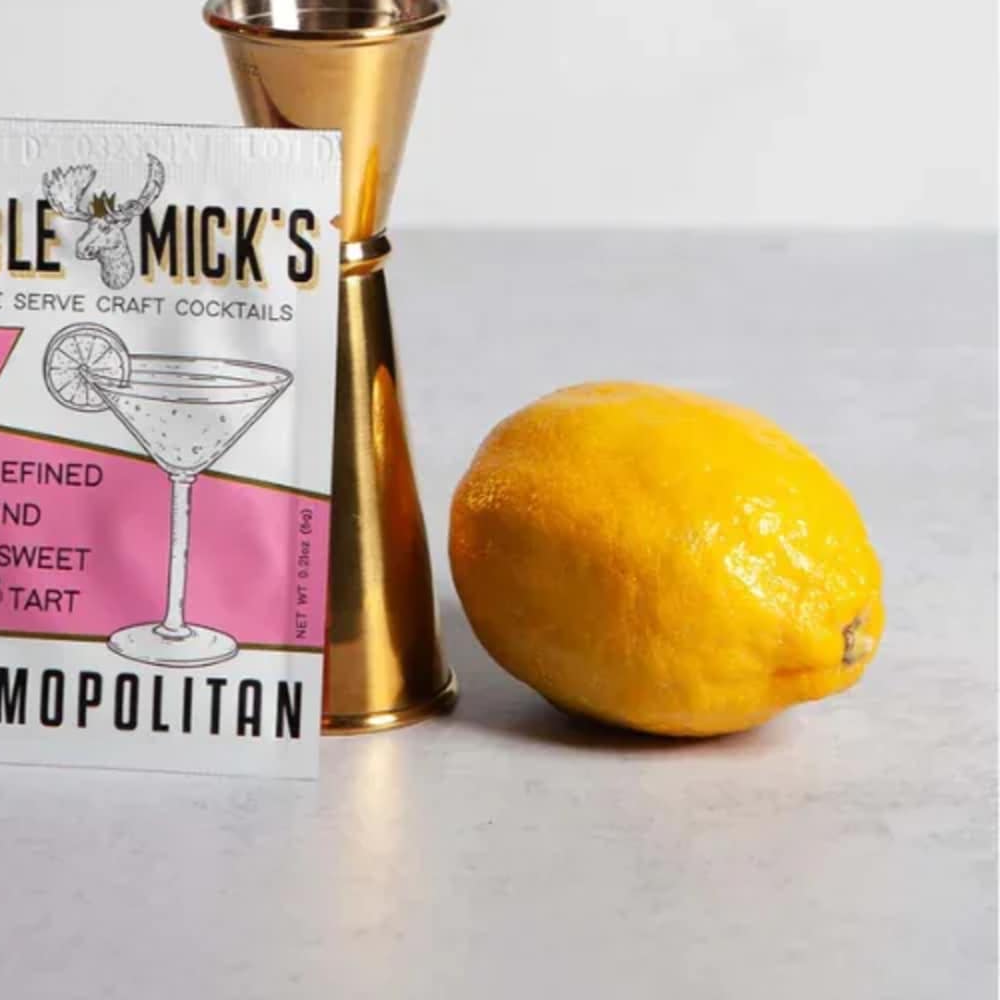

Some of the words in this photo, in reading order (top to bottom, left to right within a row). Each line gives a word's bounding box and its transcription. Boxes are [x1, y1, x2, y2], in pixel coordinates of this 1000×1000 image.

[139, 203, 321, 289] MICK'S
[13, 292, 85, 313] SERVE
[95, 295, 165, 316] CRAFT
[174, 299, 293, 321] COCKTAILS
[8, 586, 80, 614] TART
[296, 584, 308, 605] WT
[295, 611, 308, 640] NET
